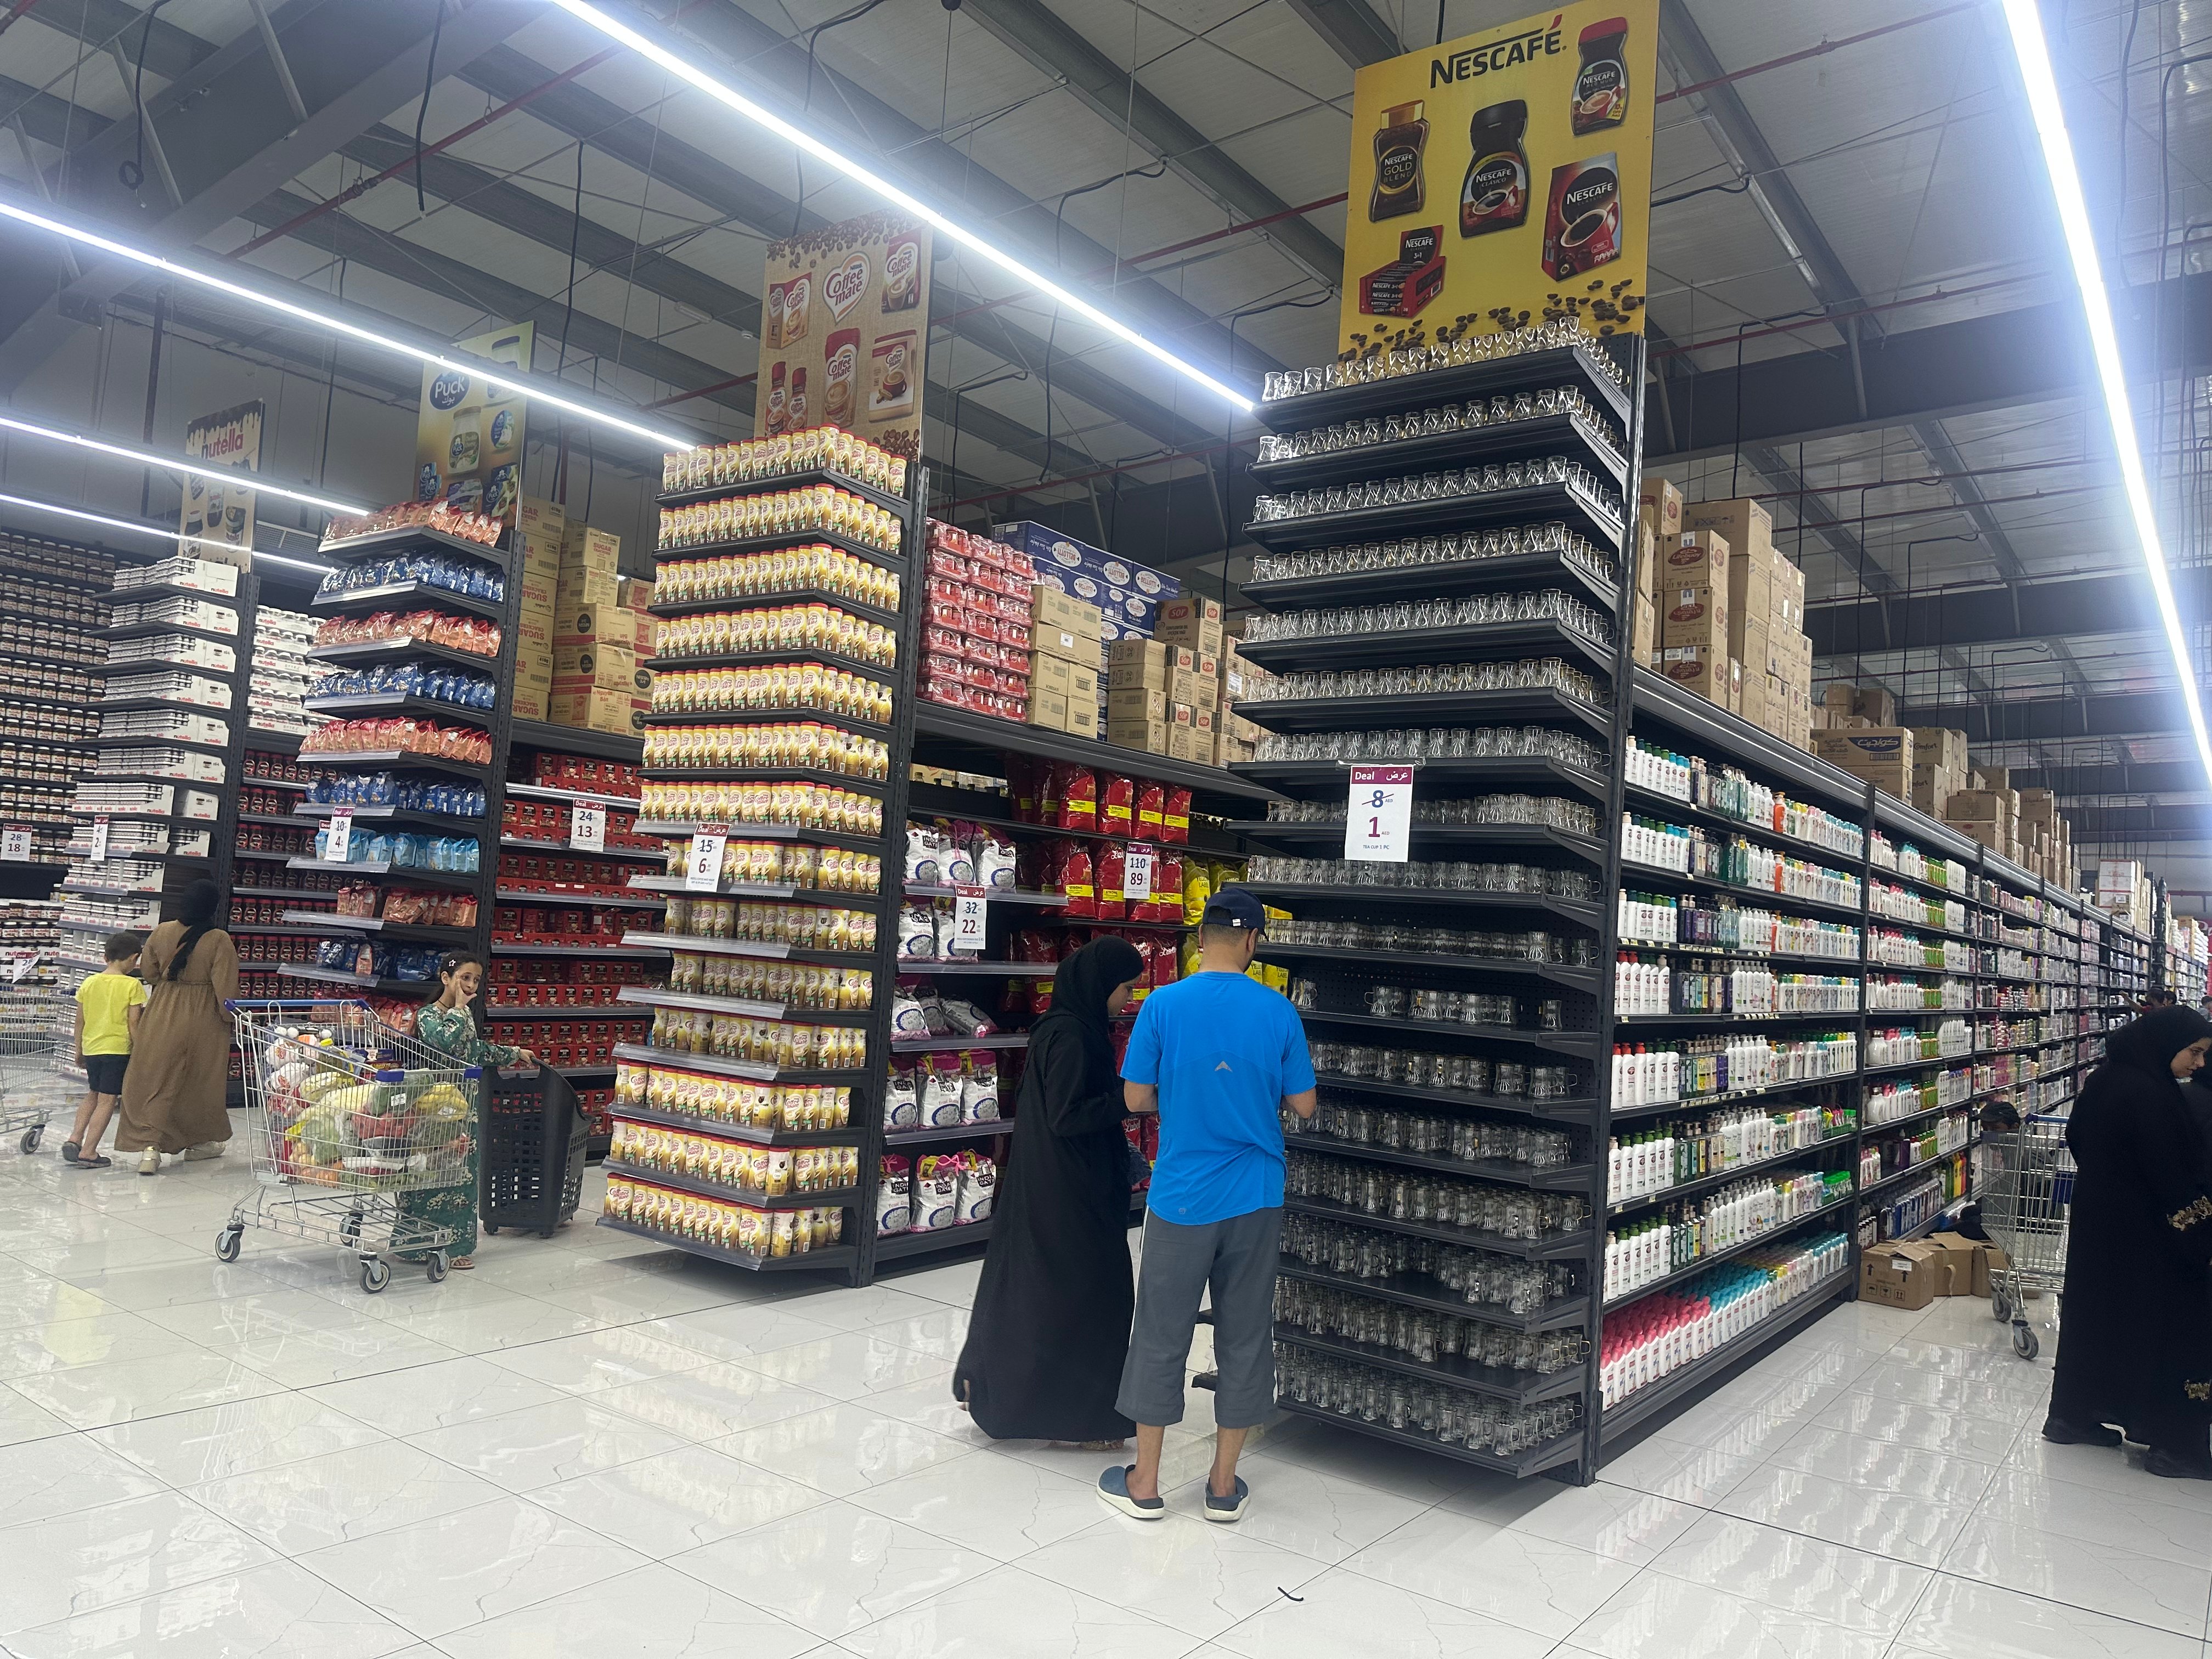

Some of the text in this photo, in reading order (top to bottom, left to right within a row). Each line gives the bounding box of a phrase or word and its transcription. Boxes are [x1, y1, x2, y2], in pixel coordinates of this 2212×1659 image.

[1430, 14, 1563, 89] NESCAFÉ
[1384, 162, 1412, 176] GOLD
[1383, 171, 1412, 183] BLEND
[887, 253, 912, 273] Coffee
[892, 261, 912, 278] mate
[826, 269, 863, 298] Coffee
[787, 289, 805, 308] Coffee
[834, 280, 863, 306] mate
[885, 353, 903, 364] Coffee
[827, 358, 851, 376] Coffee
[832, 365, 851, 381] mate
[201, 428, 244, 459] nutella
[593, 542, 612, 552] SUGAR
[1057, 548, 1076, 561] BELLOTTI
[1108, 567, 1125, 579] BELLOTTI
[1141, 577, 1157, 589] BELLOTTI
[512, 704, 539, 716] SUGAR
[514, 699, 538, 708] CRACKERS
[1857, 737, 1899, 748] كولجيت
[1914, 742, 1937, 751] Comfort
[1355, 771, 1375, 781] Deal
[1386, 770, 1408, 781] عرض
[1371, 789, 1384, 808] 8
[579, 811, 593, 822] 24
[336, 821, 345, 832] 10
[577, 825, 592, 838] 13
[1368, 816, 1380, 838] 1
[8, 843, 21, 852] 18
[94, 837, 99, 848] 2
[335, 836, 341, 848] 4
[699, 839, 713, 853] 15
[698, 858, 707, 873] 6
[1130, 857, 1147, 869] 110
[1130, 872, 1143, 885] 89
[964, 901, 978, 914] 32
[962, 919, 976, 934] 22
